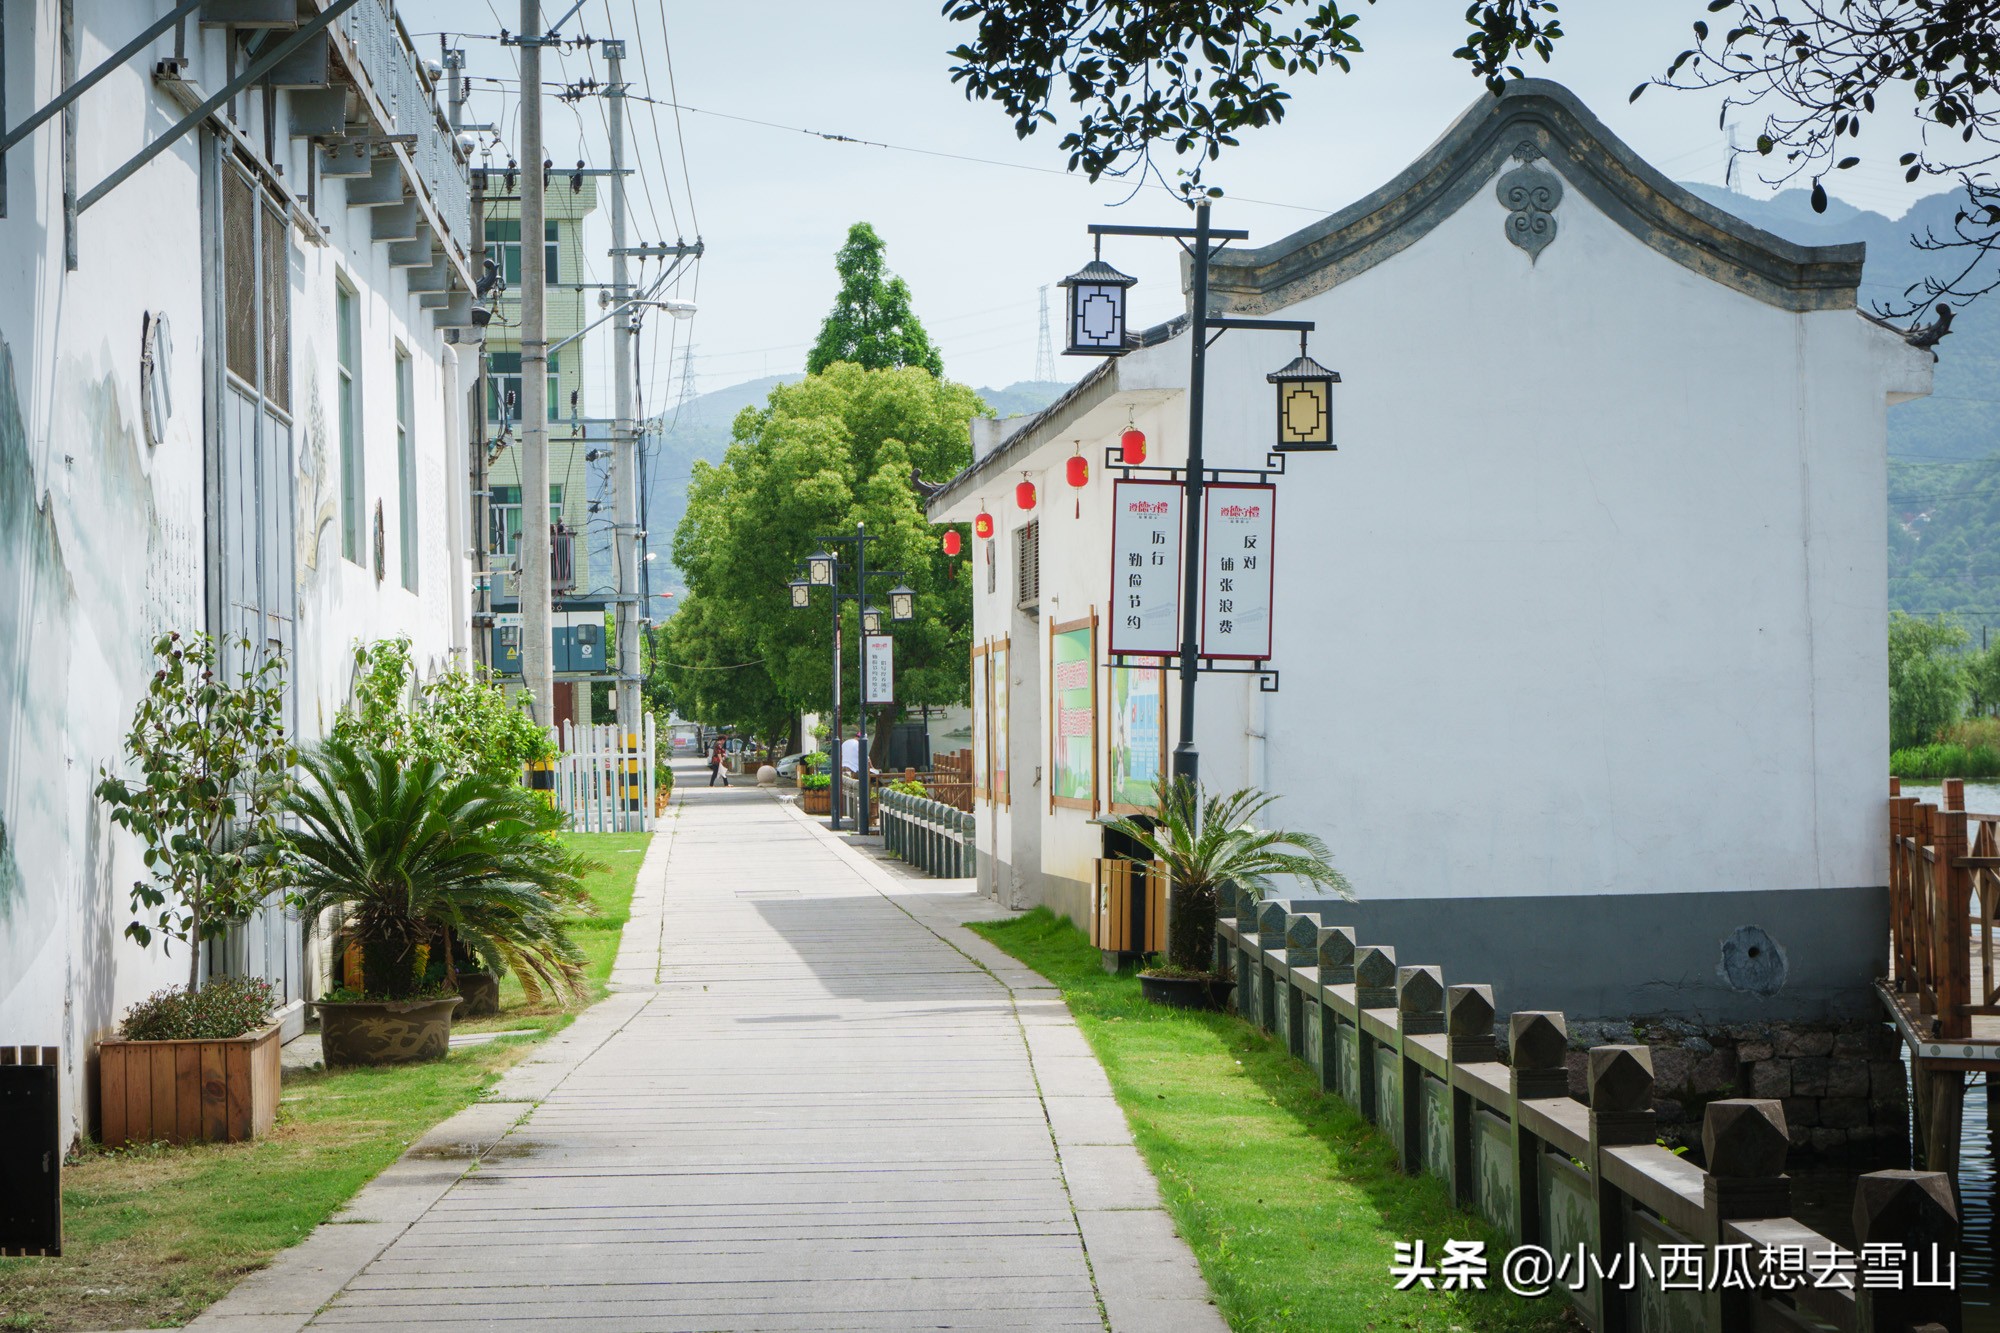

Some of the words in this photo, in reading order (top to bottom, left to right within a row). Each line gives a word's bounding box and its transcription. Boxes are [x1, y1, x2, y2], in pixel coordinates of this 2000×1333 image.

[1152, 530, 1166, 566] 厉行
[1243, 534, 1257, 570] 反对
[1127, 552, 1143, 630] 勤俭节约
[1218, 557, 1234, 634] 铺张浪费
